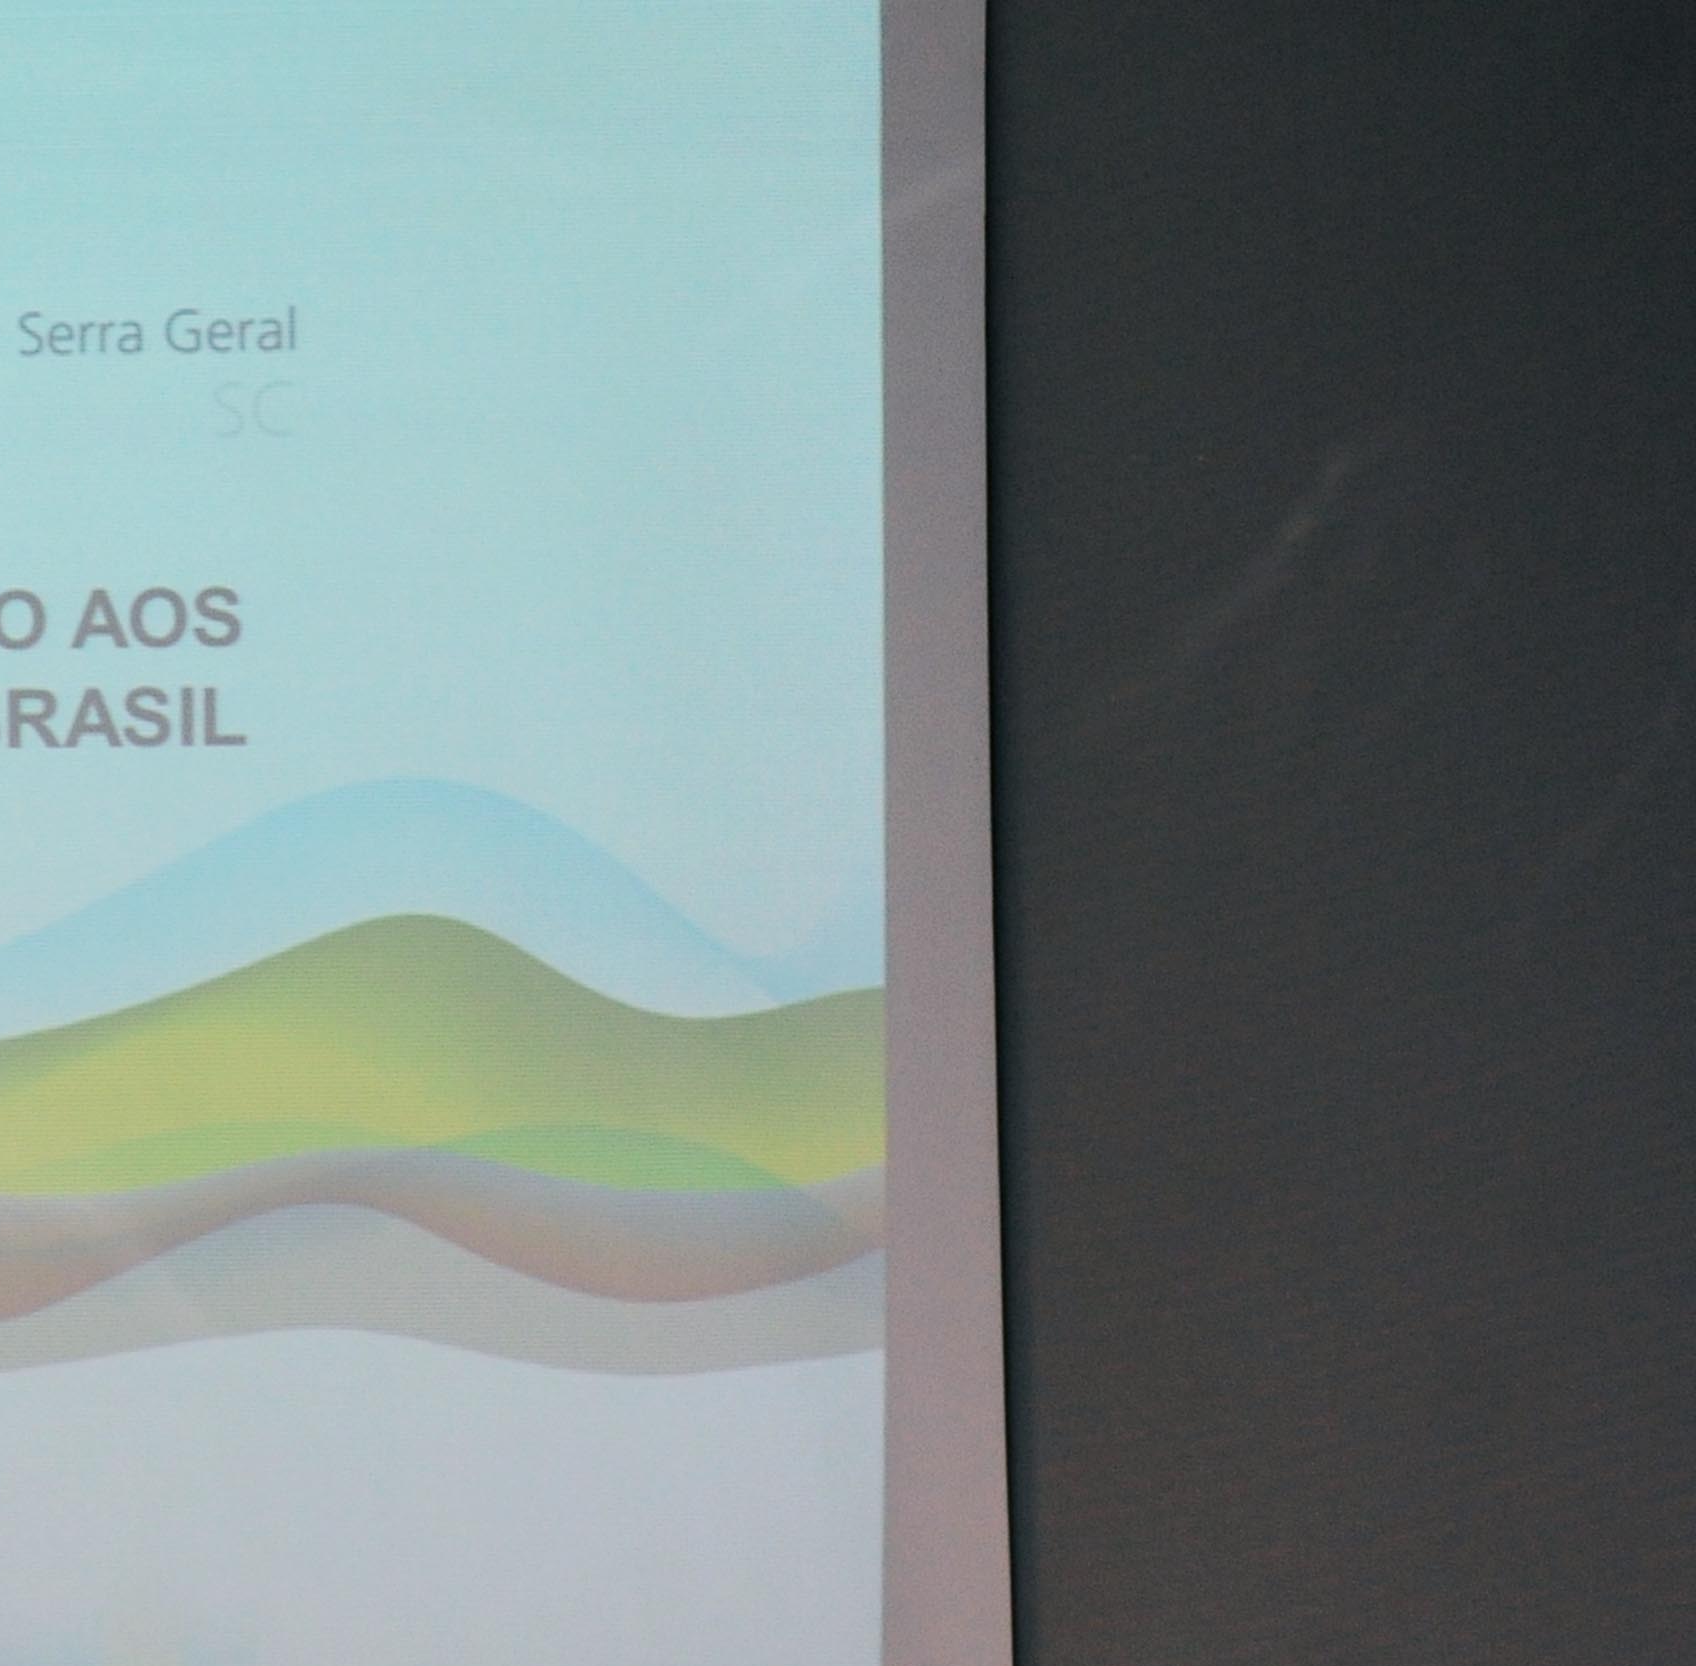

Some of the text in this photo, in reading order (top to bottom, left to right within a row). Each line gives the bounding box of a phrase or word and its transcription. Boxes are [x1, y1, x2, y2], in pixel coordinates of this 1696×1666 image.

[18, 311, 144, 357] Serra
[164, 305, 297, 354] Geral
[212, 379, 295, 439] SC
[72, 587, 241, 649] AOS
